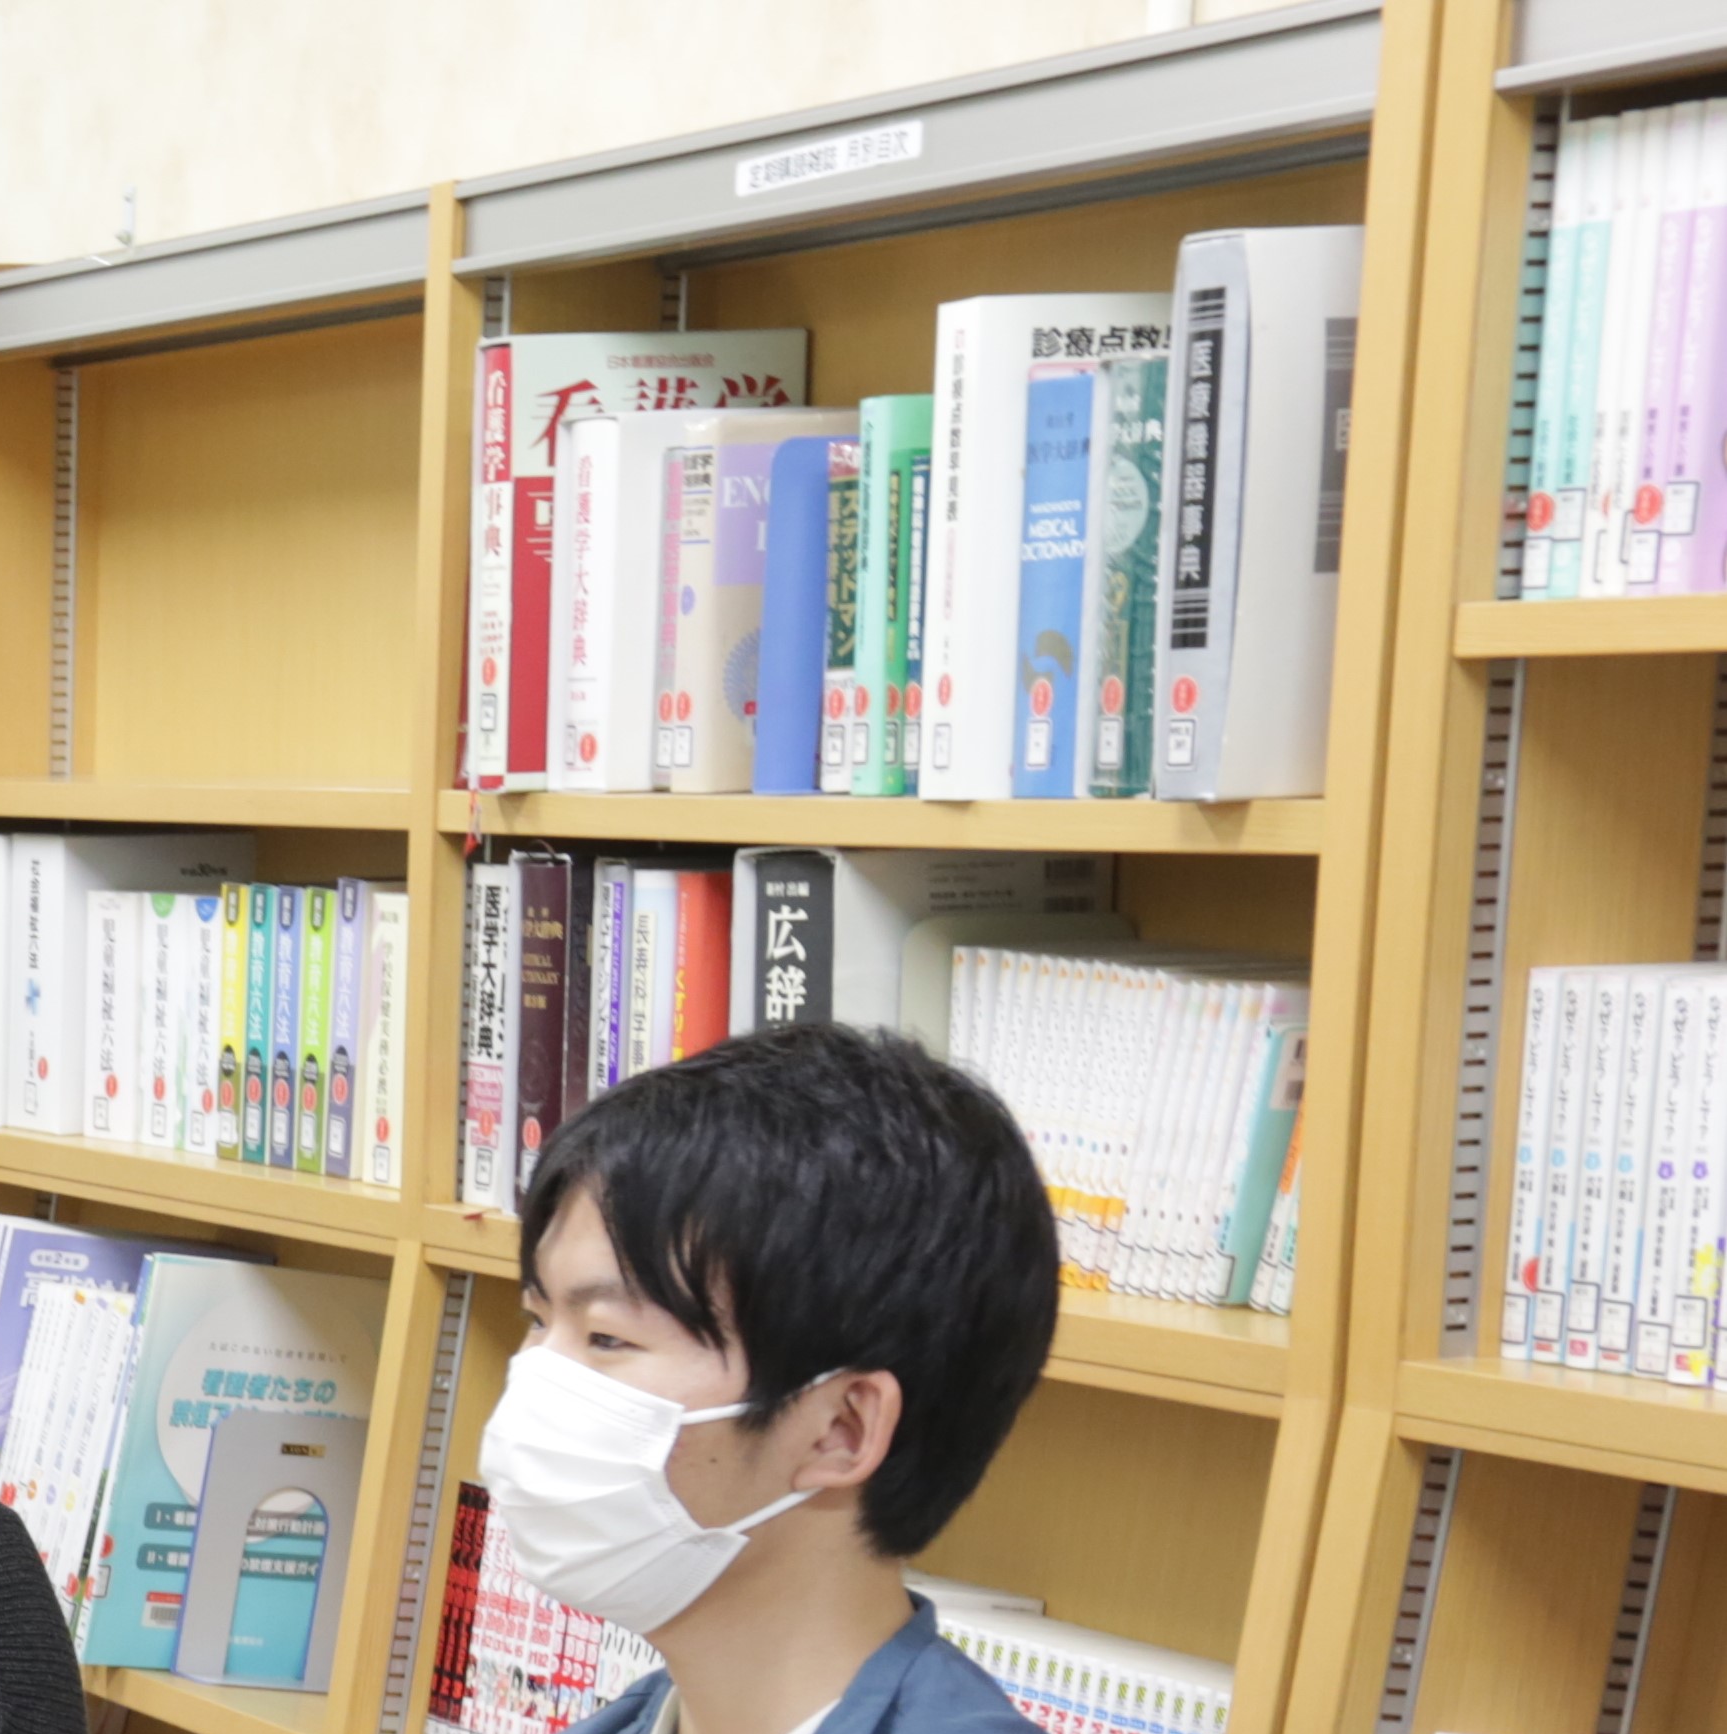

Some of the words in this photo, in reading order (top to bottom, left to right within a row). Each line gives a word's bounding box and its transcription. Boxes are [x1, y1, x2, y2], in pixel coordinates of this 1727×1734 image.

[1032, 326, 1171, 358] 診療点数
[1028, 517, 1079, 539] MEDICAL
[478, 885, 501, 1059] 医学大辞典
[765, 903, 810, 1026] 広辞
[201, 1367, 338, 1405] 看護者たちの
